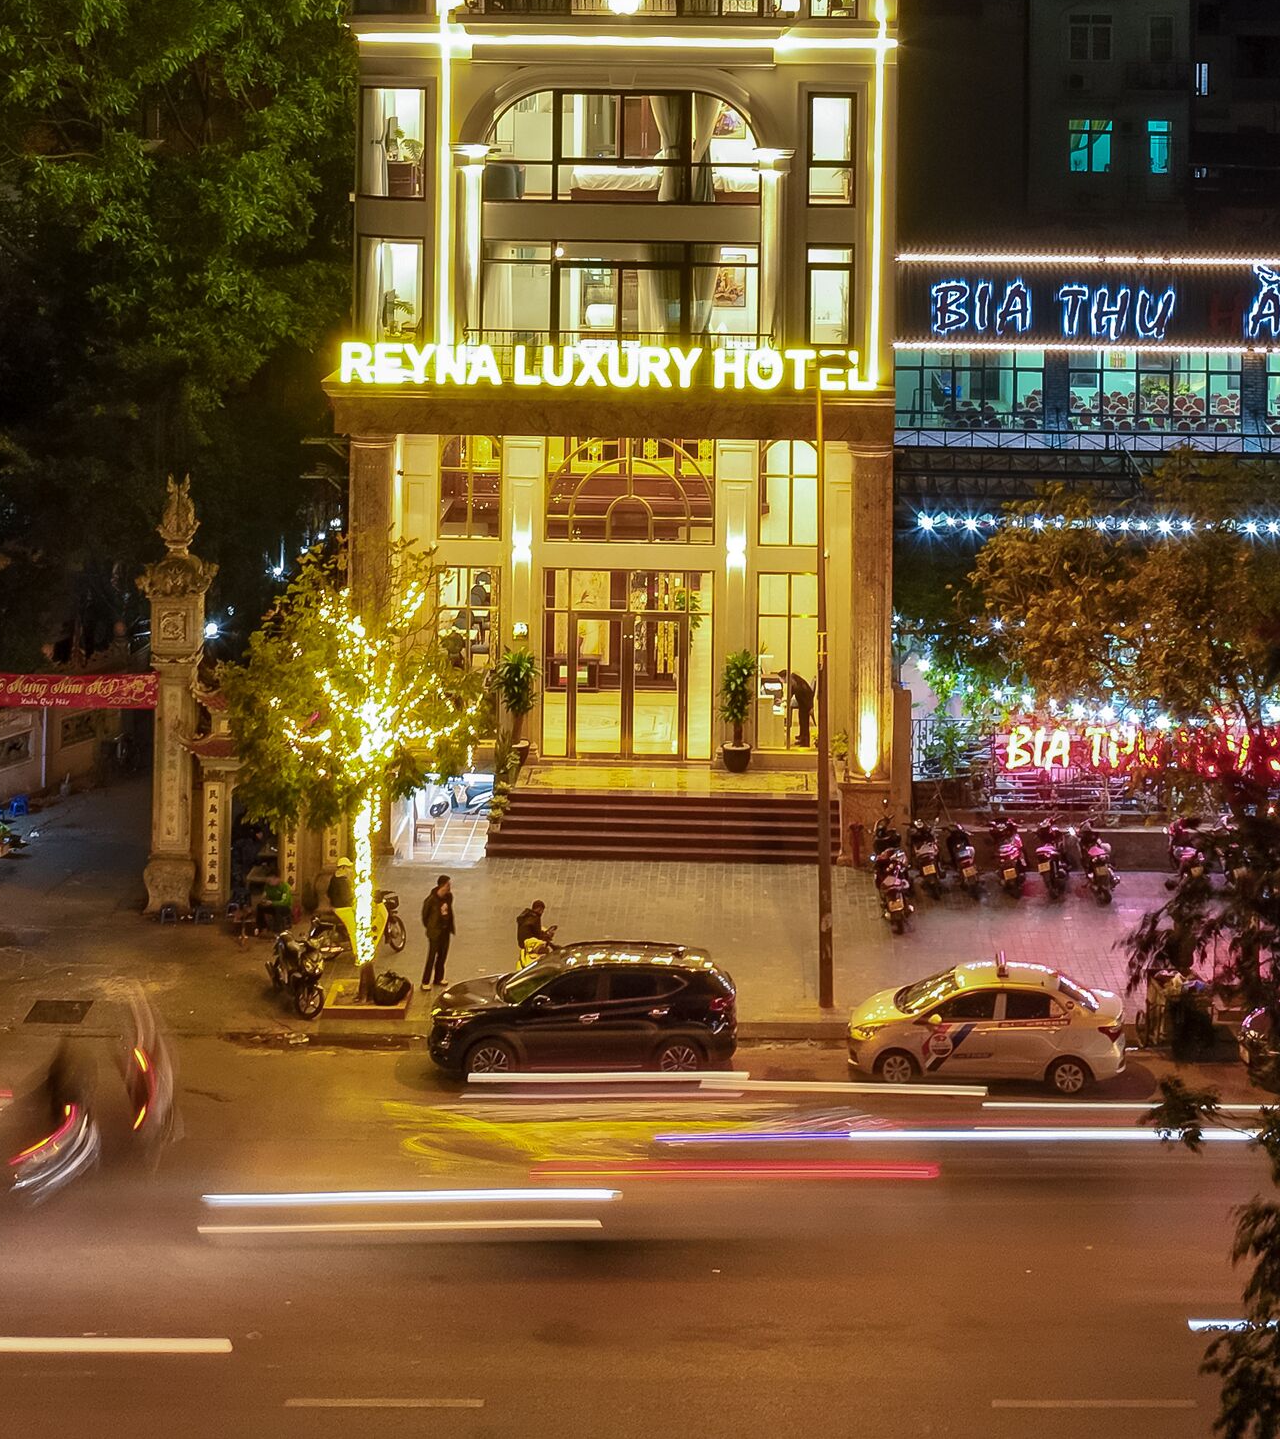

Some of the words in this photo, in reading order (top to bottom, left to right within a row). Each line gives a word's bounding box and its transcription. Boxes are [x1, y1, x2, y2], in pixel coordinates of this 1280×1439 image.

[931, 281, 1032, 334] BIA
[1059, 285, 1176, 342] THU
[340, 341, 503, 386] REYNA
[514, 343, 702, 389] LUXURY
[713, 348, 878, 391] HOTEL
[1006, 725, 1071, 770] BIA
